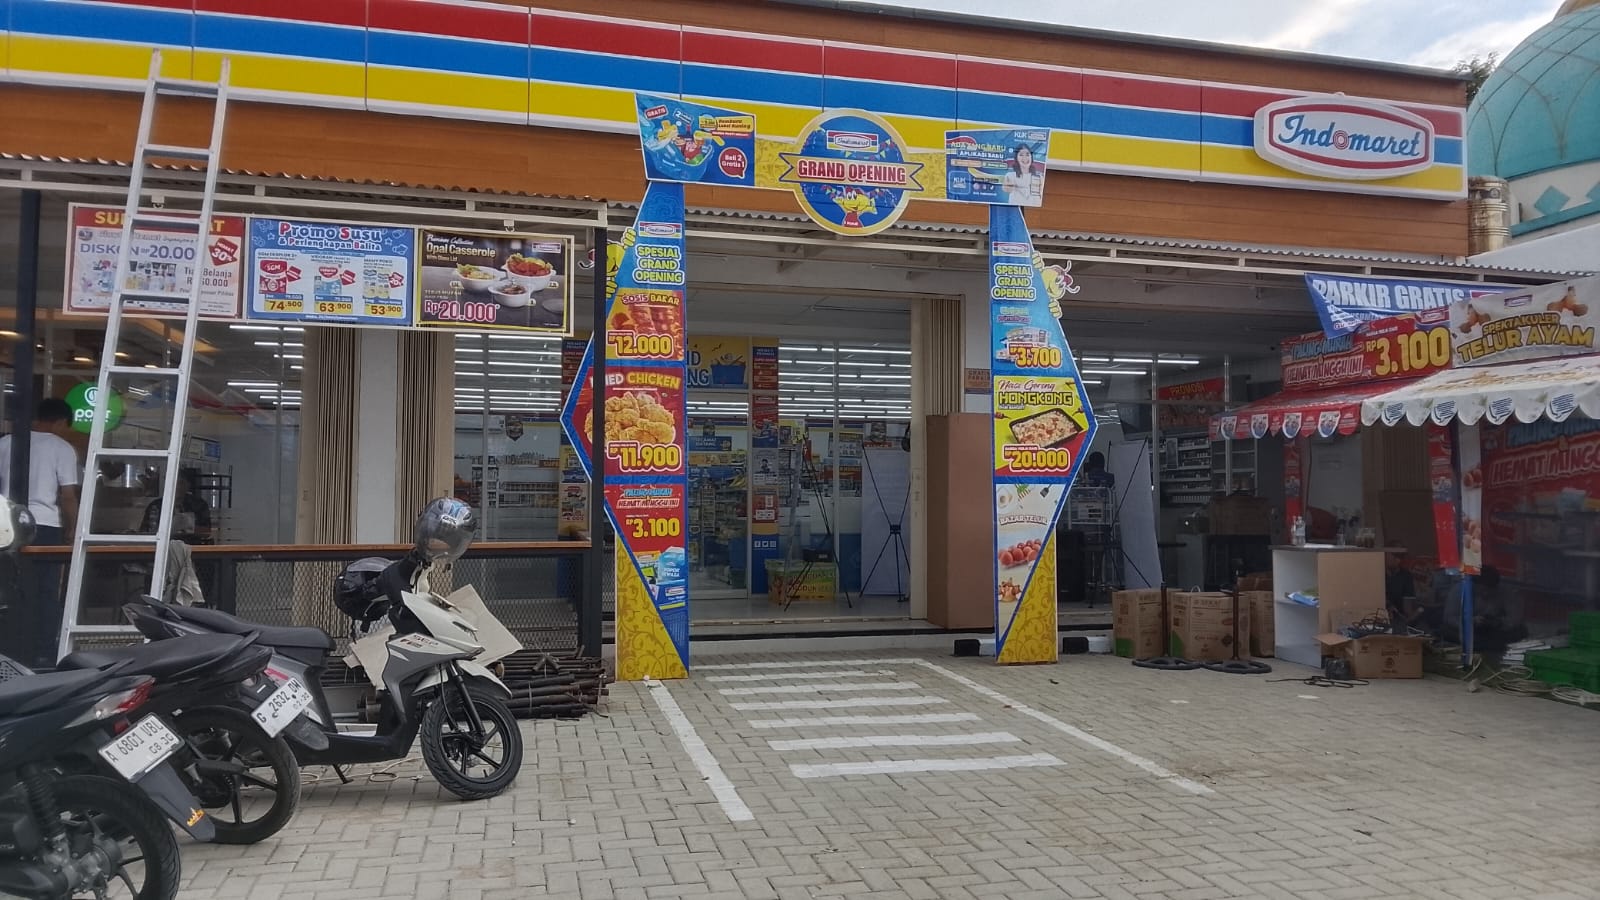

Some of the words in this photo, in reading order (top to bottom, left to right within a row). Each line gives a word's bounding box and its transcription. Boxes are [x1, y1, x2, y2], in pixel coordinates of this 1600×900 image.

[1278, 114, 1421, 157] Indomaret
[798, 160, 845, 178] GRAND
[848, 163, 906, 183] OPENING
[279, 222, 337, 239] Promo
[340, 227, 382, 242] Susu
[289, 237, 353, 250] Perlengkapan
[354, 242, 382, 251] Balita
[426, 242, 448, 254] Opal
[449, 244, 496, 258] Casserole
[637, 246, 679, 258] SPESIAL
[639, 259, 677, 270] GRAND
[996, 265, 1032, 276] SPESIAL
[203, 268, 232, 279] Belanja
[634, 271, 682, 282] OPENING
[997, 277, 1031, 287] GRAND
[650, 293, 679, 305] BAKAR
[993, 288, 1034, 298] OPENING
[1312, 279, 1392, 308] PARKIR
[1394, 284, 1465, 310] GRATIS
[1482, 312, 1560, 335] SPEKTAKULER
[1457, 328, 1522, 363] TELUR
[1526, 324, 1595, 349] AYAM
[626, 372, 682, 390] CHICKEN
[998, 391, 1073, 406] HONGKONG
[269, 691, 290, 712] 2632
[105, 750, 119, 762] A
[116, 732, 144, 755] 6801
